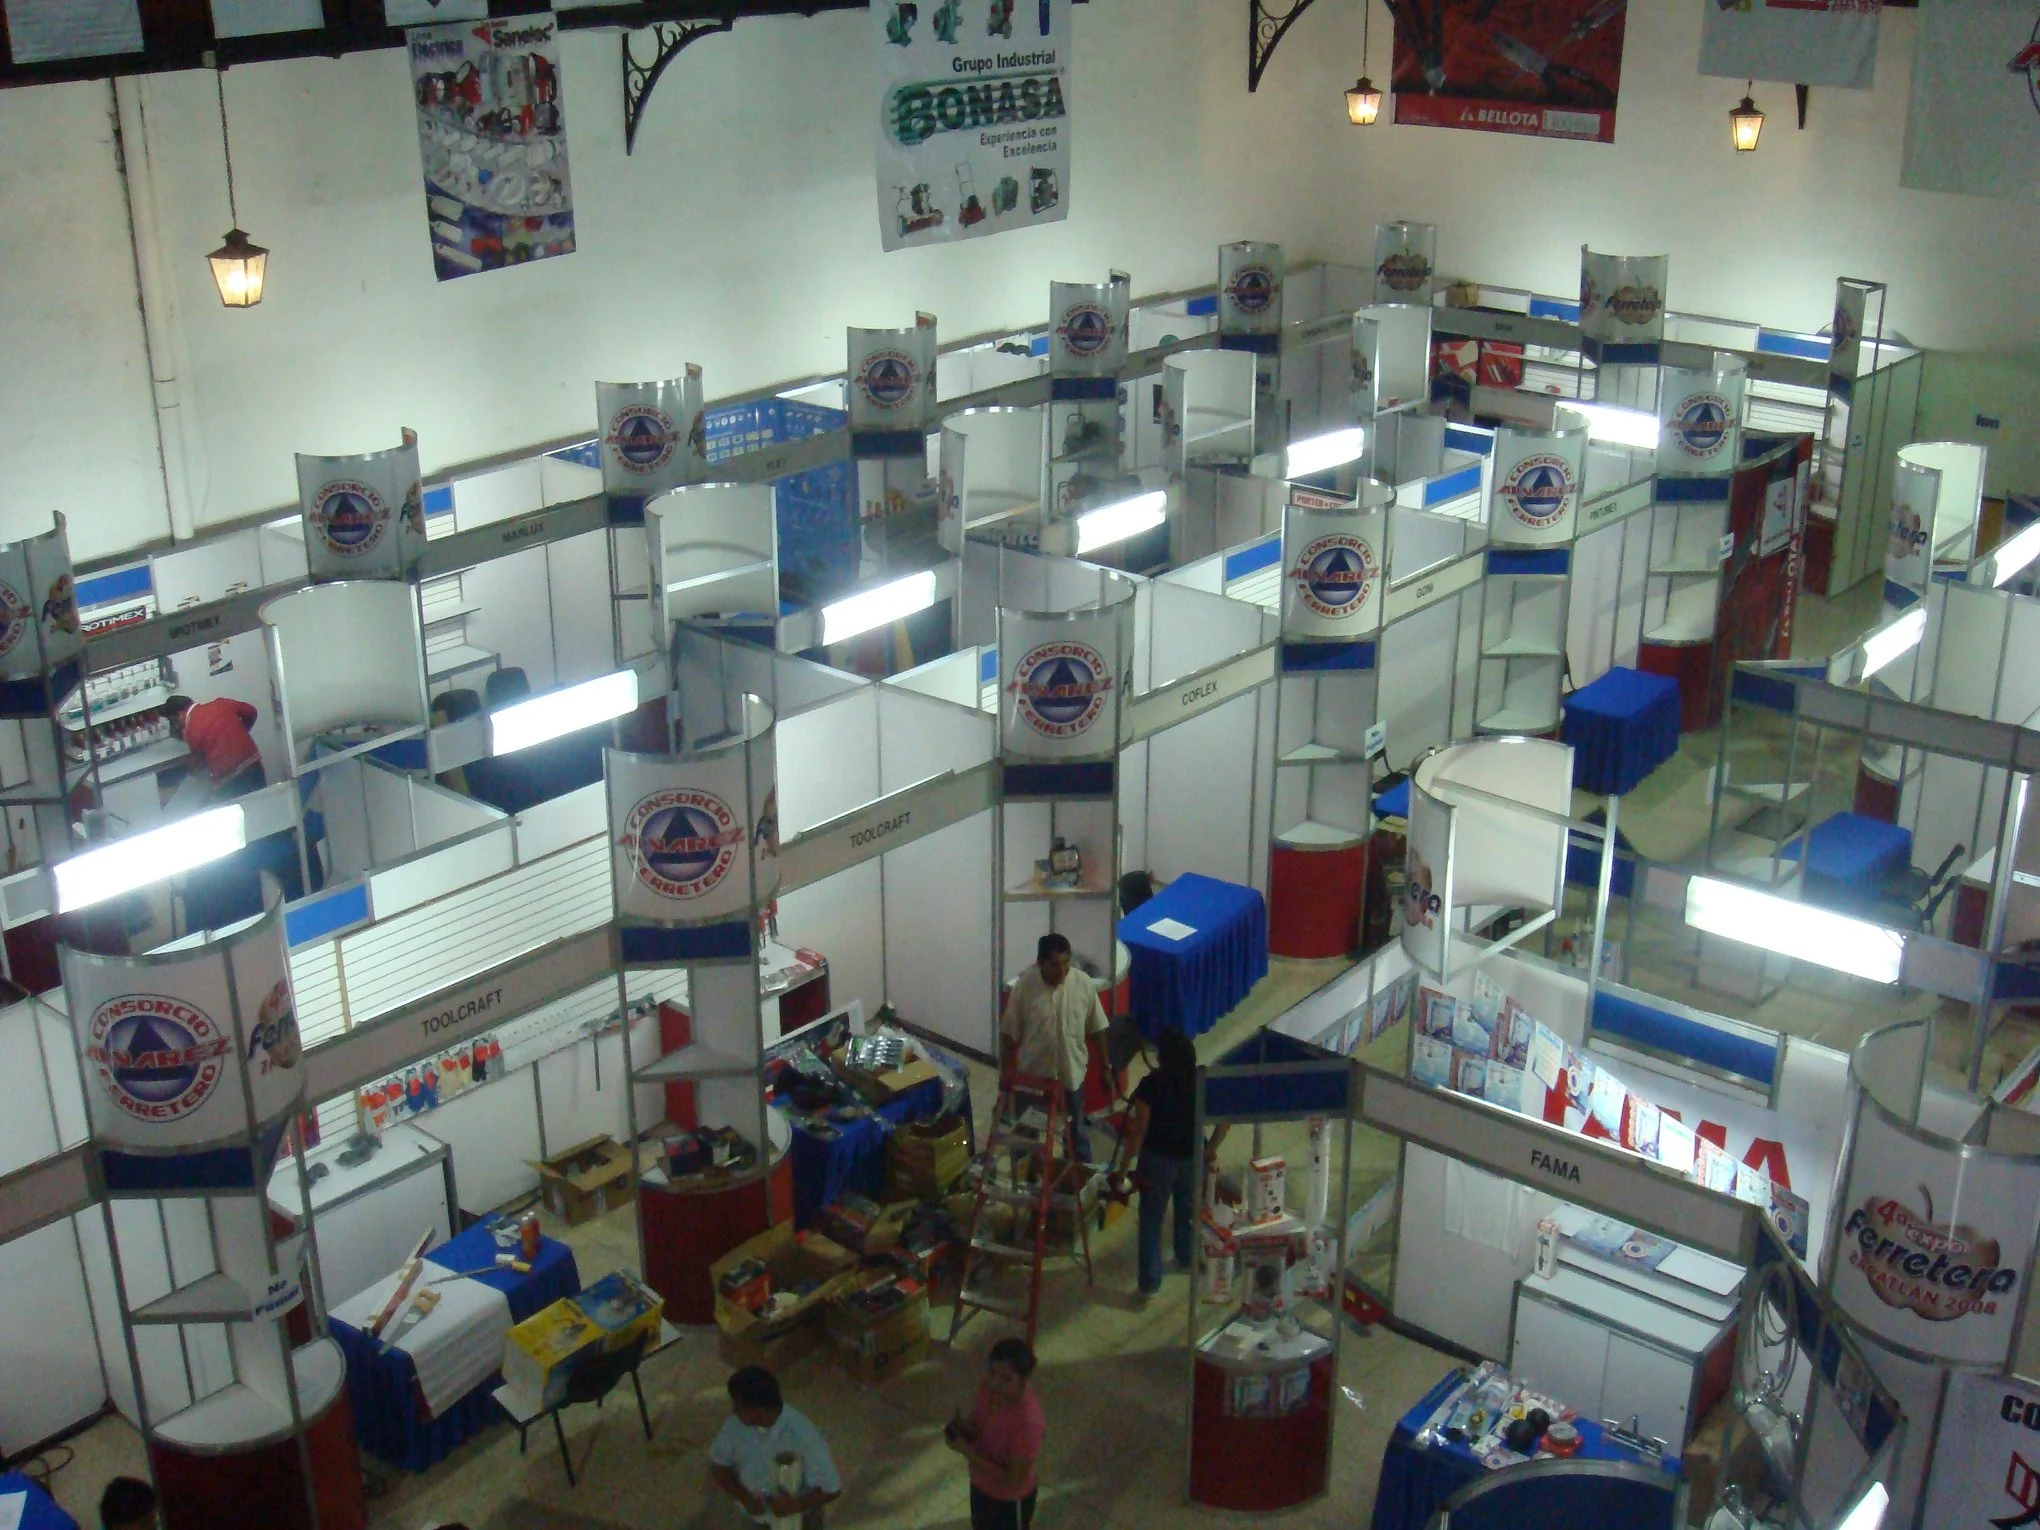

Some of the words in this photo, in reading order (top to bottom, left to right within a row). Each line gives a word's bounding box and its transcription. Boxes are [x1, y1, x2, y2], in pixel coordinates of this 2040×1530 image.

[952, 56, 993, 75] Grupo
[996, 50, 1056, 69] Industrial
[889, 76, 1066, 147] BONASA
[1477, 109, 1539, 127] BELLOTA
[980, 130, 1037, 146] Experiencia
[1040, 126, 1057, 137] con
[1003, 140, 1057, 158] Excelencia
[1018, 645, 1103, 678] CONSORCIO
[1182, 680, 1217, 705] COFLEX
[629, 792, 731, 829] CONSORCIO
[850, 811, 911, 848] TOOLCRAFT
[92, 998, 211, 1042] CONSORCIO
[421, 988, 502, 1036] TOOLCRAFT
[85, 1034, 233, 1069] ALVAREZ
[1531, 1149, 1582, 1184] FAMA
[1845, 1208, 2017, 1293] Ferretera
[1906, 1226, 1965, 1255] expo
